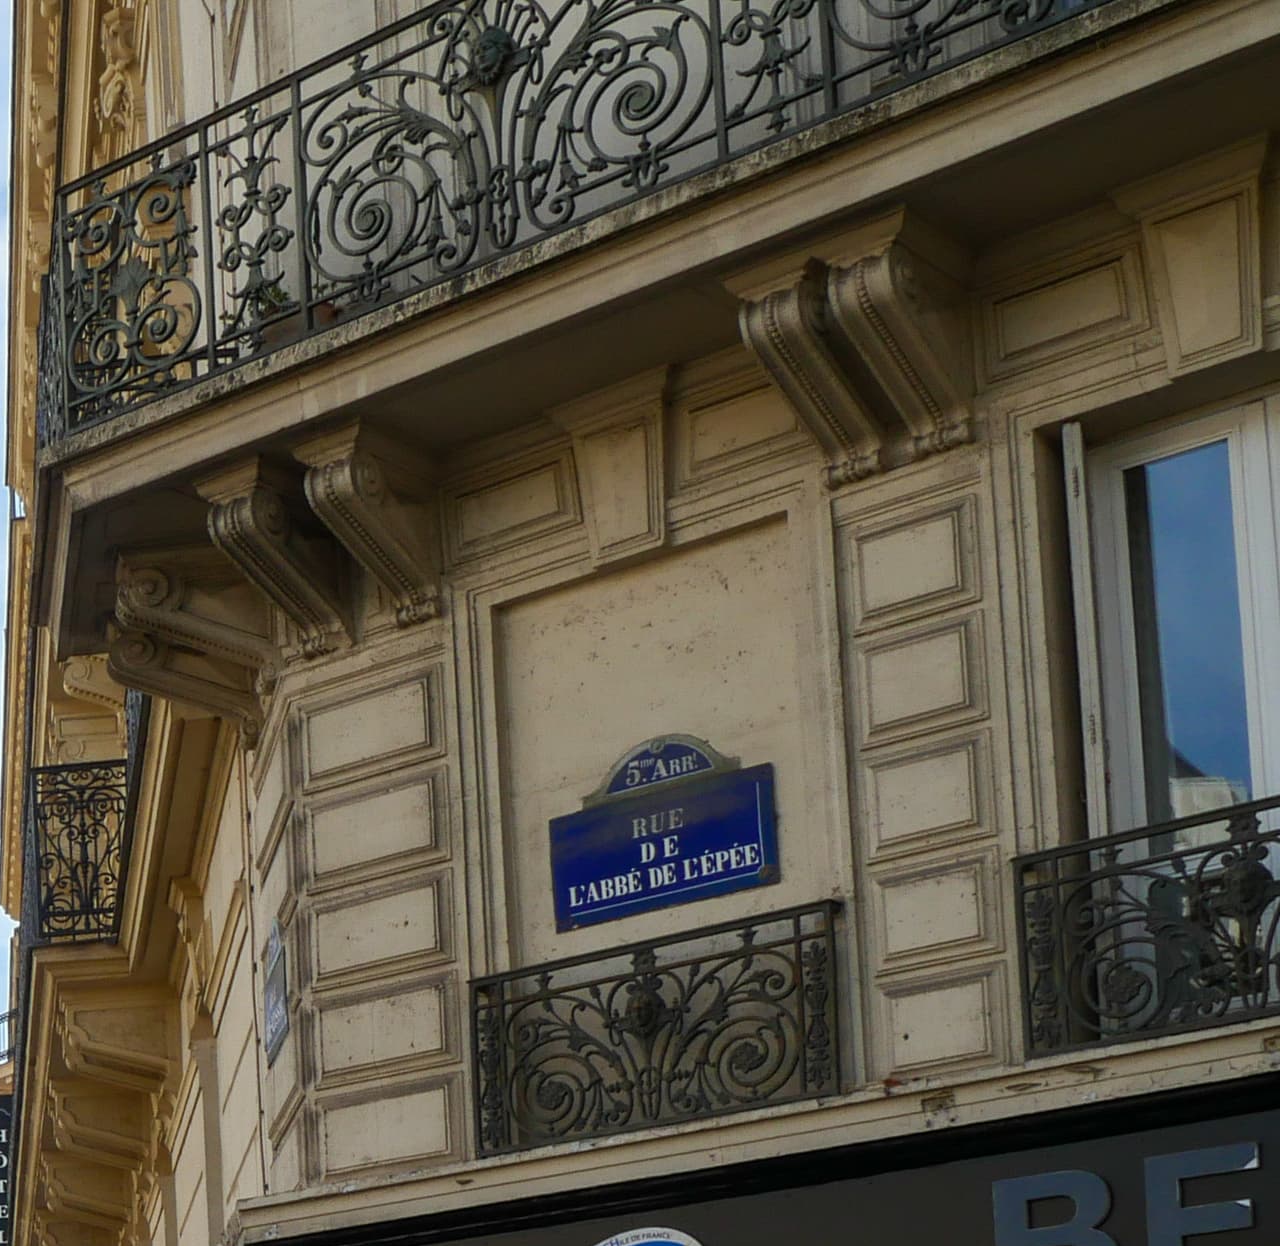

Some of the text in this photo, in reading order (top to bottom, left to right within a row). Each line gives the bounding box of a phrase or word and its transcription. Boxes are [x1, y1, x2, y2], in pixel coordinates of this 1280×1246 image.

[632, 808, 684, 838] RUE
[640, 835, 679, 863] DE
[569, 843, 760, 907] L'ABBÉ DE L'ÉPÉE
